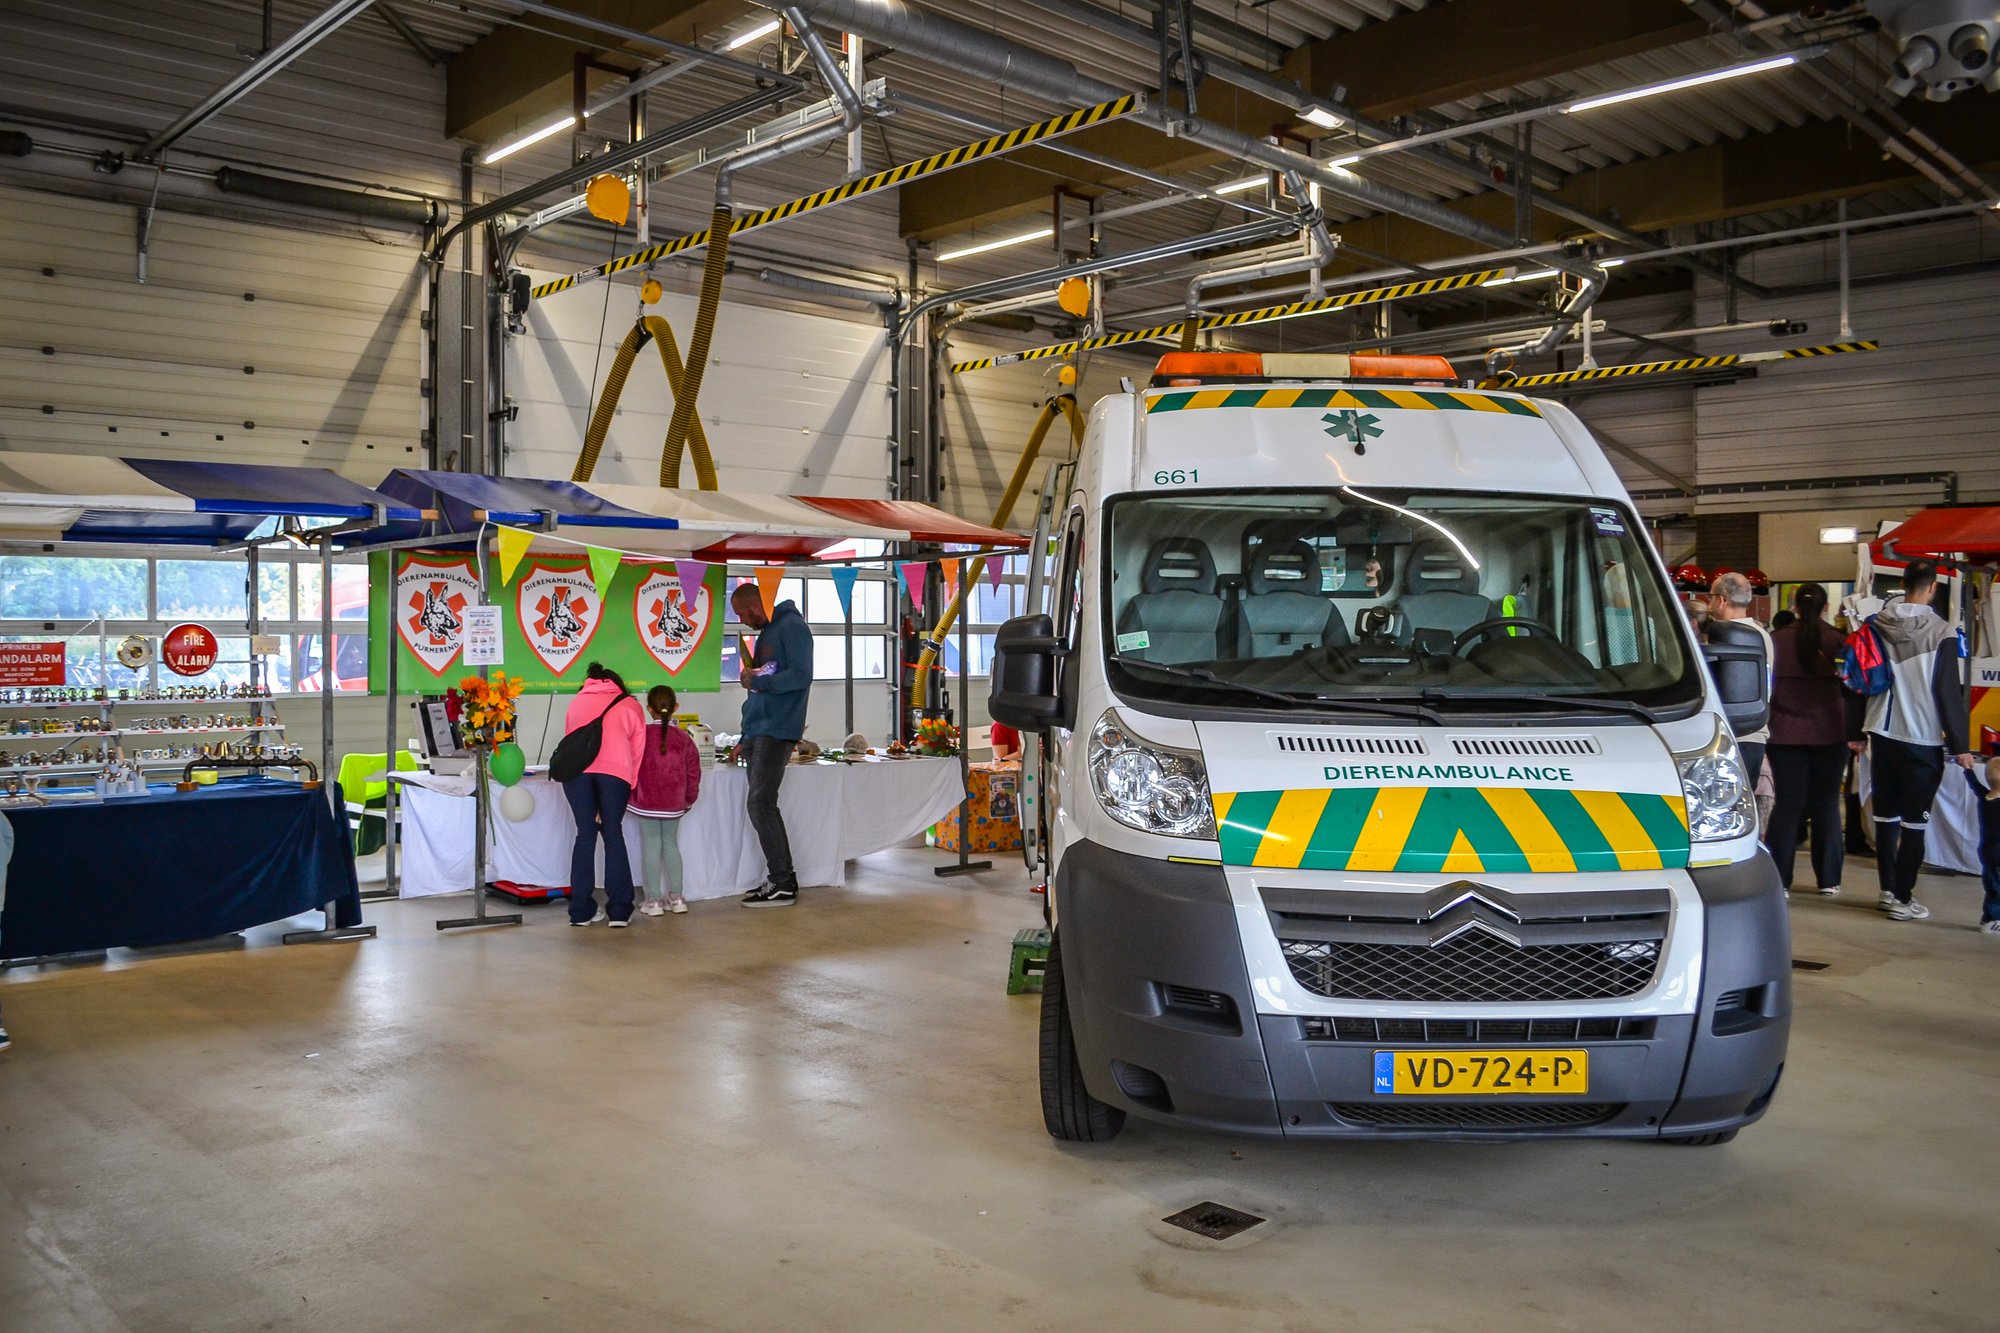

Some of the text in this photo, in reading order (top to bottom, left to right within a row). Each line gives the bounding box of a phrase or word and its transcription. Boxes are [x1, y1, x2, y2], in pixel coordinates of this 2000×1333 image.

[1154, 469, 1198, 485] 661
[397, 572, 479, 591] DIERENAMBULANCE
[641, 581, 704, 597] DIERENAMBE
[183, 634, 205, 646] FIRE
[414, 642, 460, 654] PURMEREND
[537, 644, 581, 656] PURMEREND
[651, 644, 693, 656] PURMEREND
[0, 653, 62, 664] NDALARM
[177, 654, 210, 666] ALARM
[1323, 765, 1574, 782] DIERENAMBULANCE
[1407, 1057, 1573, 1088] VD-724-P
[1376, 1076, 1391, 1087] NL
